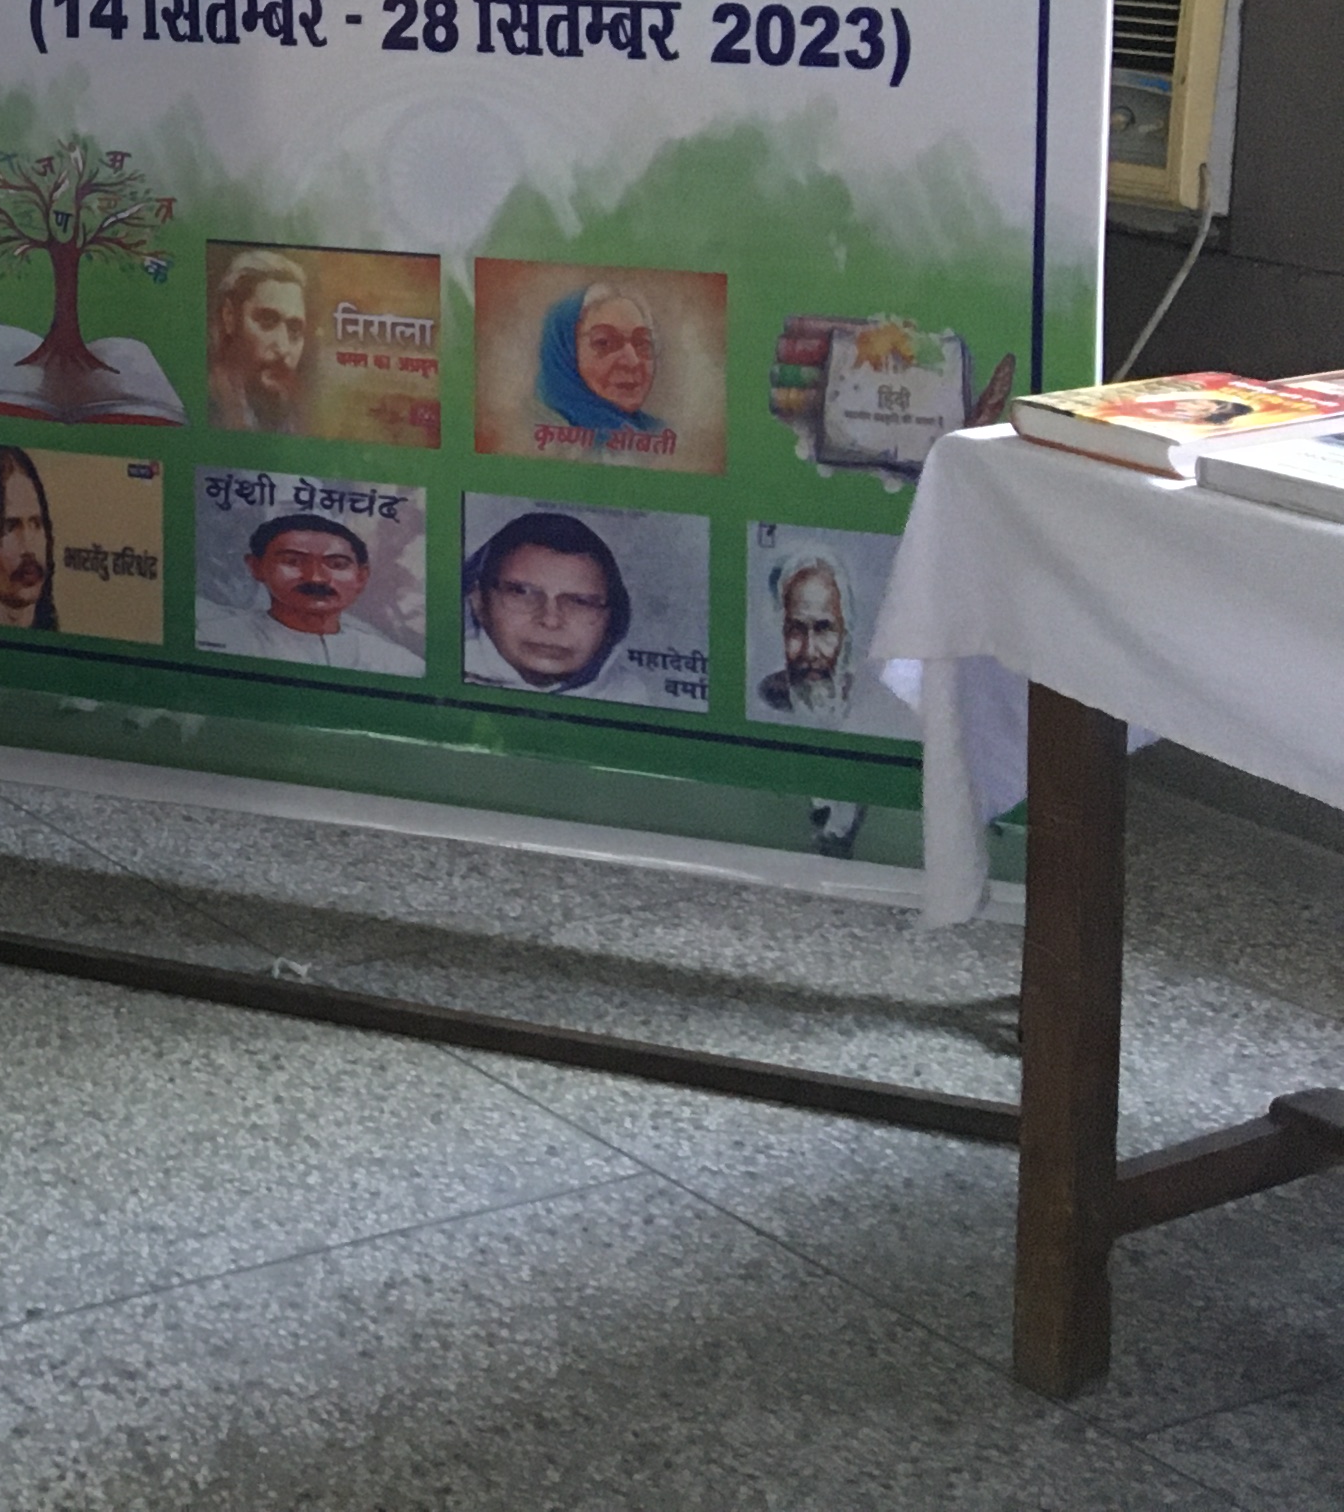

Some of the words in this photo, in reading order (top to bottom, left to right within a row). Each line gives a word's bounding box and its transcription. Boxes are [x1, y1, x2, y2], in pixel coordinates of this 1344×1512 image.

[711, 2, 913, 88] 2023)
[333, 301, 435, 347] निराला
[877, 383, 912, 412] हिंदी
[534, 423, 596, 452] कृष्णा
[606, 423, 678, 456] सोबती
[204, 473, 276, 512] मुंशी
[293, 476, 409, 524] प्रेमचंद
[627, 646, 709, 674] महादेवी
[664, 677, 709, 700] वर्मा
